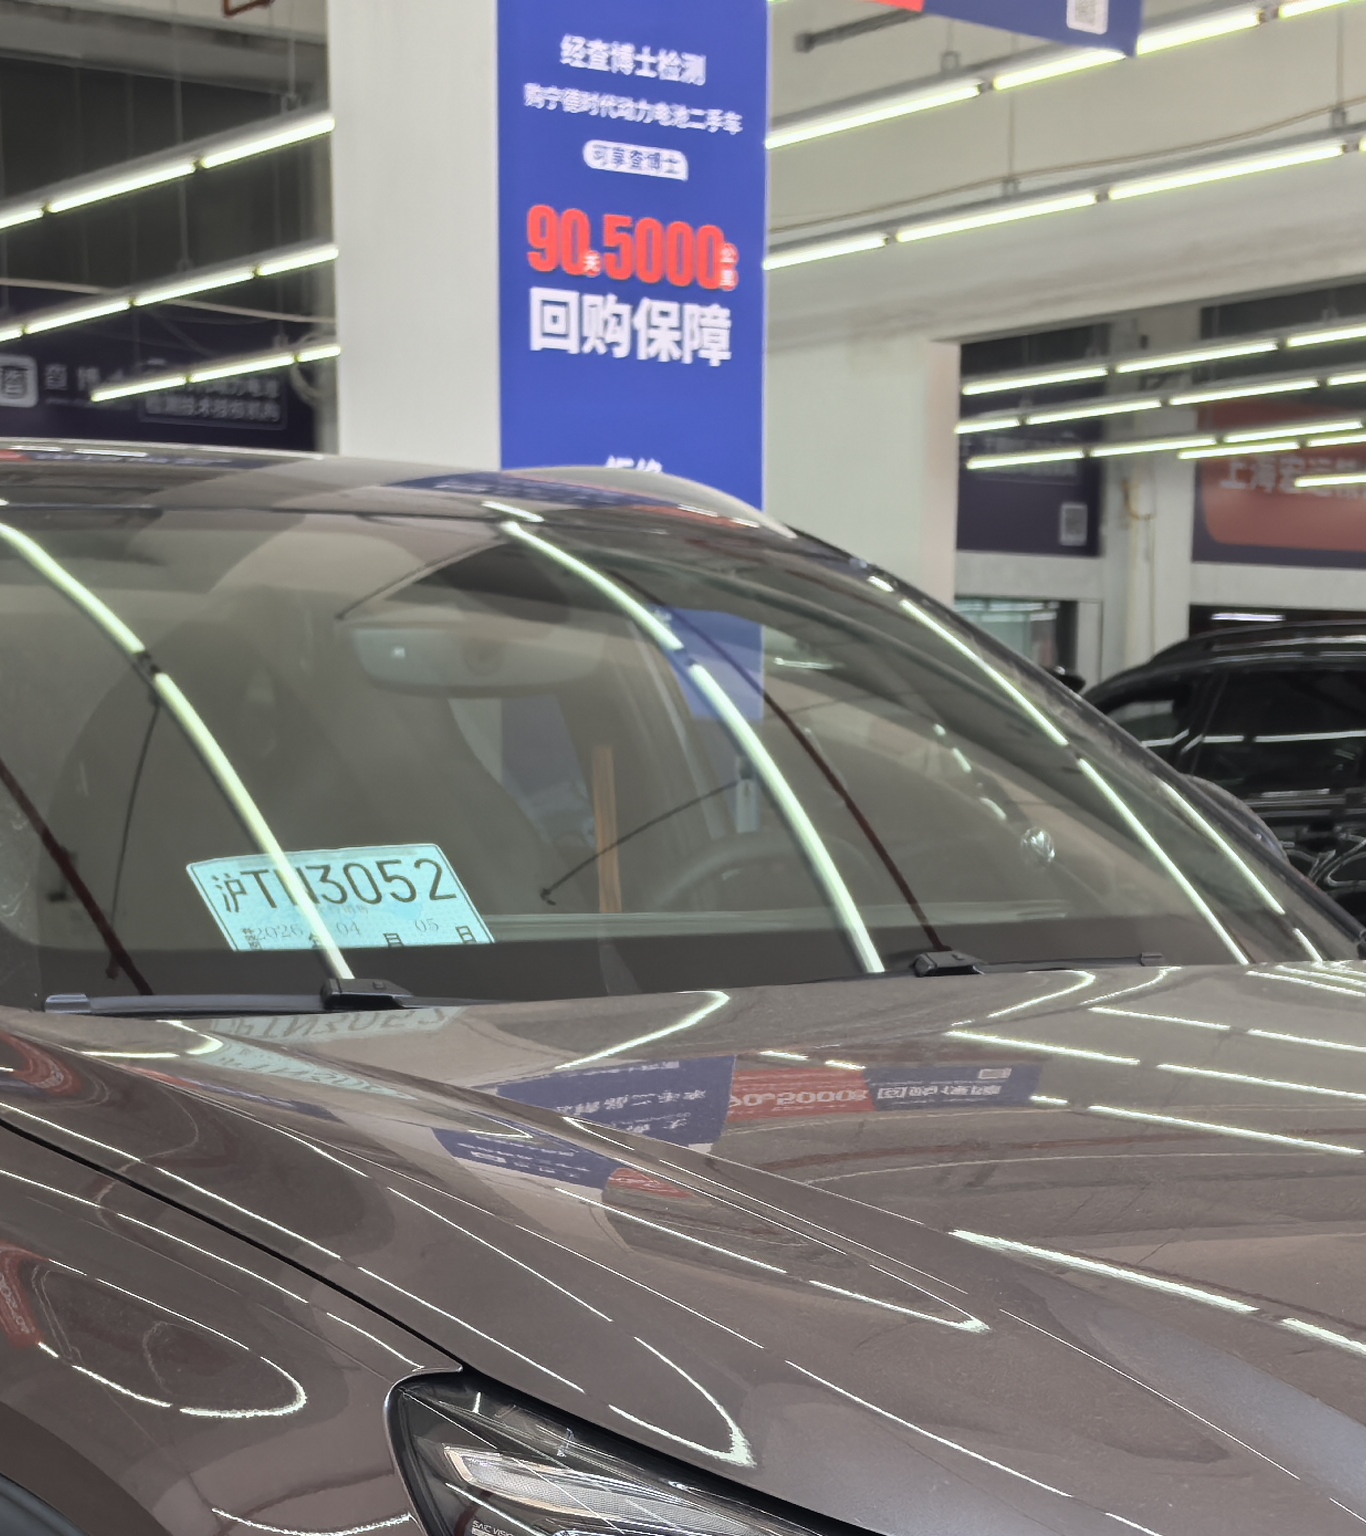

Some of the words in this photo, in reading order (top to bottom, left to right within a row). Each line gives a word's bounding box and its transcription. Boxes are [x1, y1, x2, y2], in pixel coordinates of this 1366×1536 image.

[559, 33, 707, 86] 经查博士检测
[529, 286, 733, 367] 回购保障
